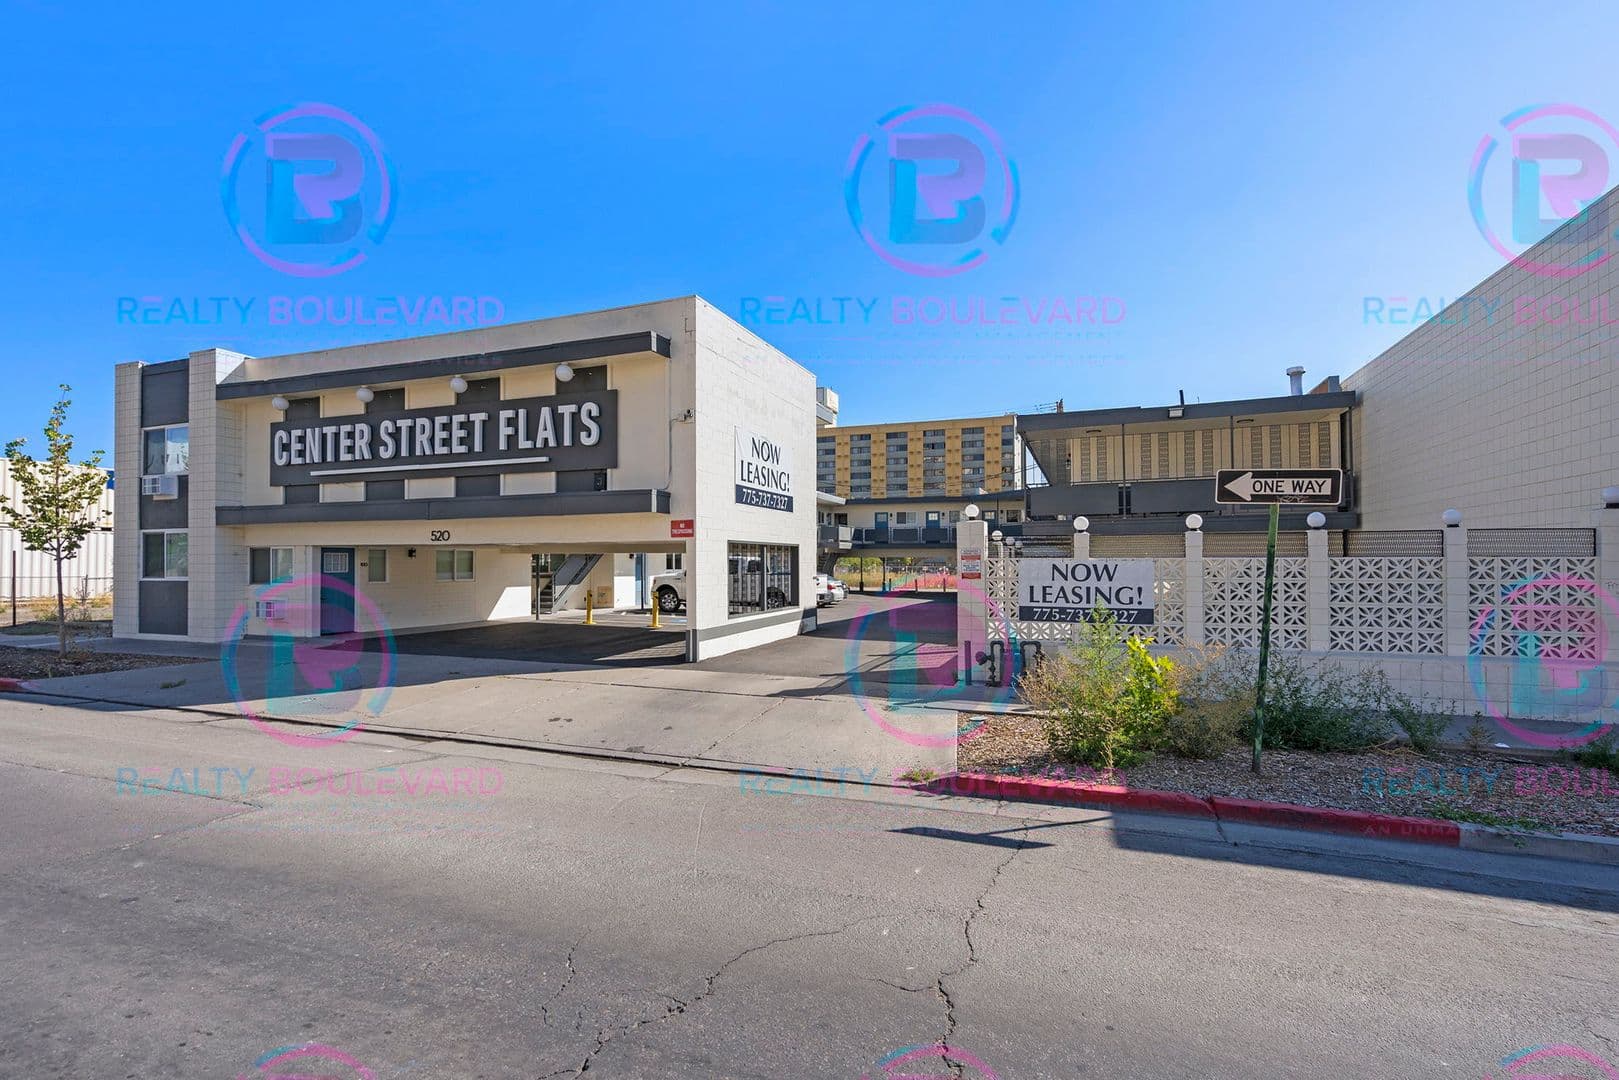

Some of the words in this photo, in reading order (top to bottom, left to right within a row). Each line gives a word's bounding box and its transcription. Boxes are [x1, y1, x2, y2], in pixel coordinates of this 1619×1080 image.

[273, 422, 374, 467] CENTER
[378, 412, 490, 460] STREET
[497, 402, 602, 451] FLATS
[751, 437, 781, 466] NOW
[740, 459, 790, 492] LEASING!
[1252, 479, 1285, 493] ONE
[1291, 479, 1327, 493] WAY
[742, 488, 789, 510] 775-737-7327
[430, 530, 451, 542] 520
[1049, 562, 1119, 583] NOW
[1028, 583, 1144, 606] LEASING!
